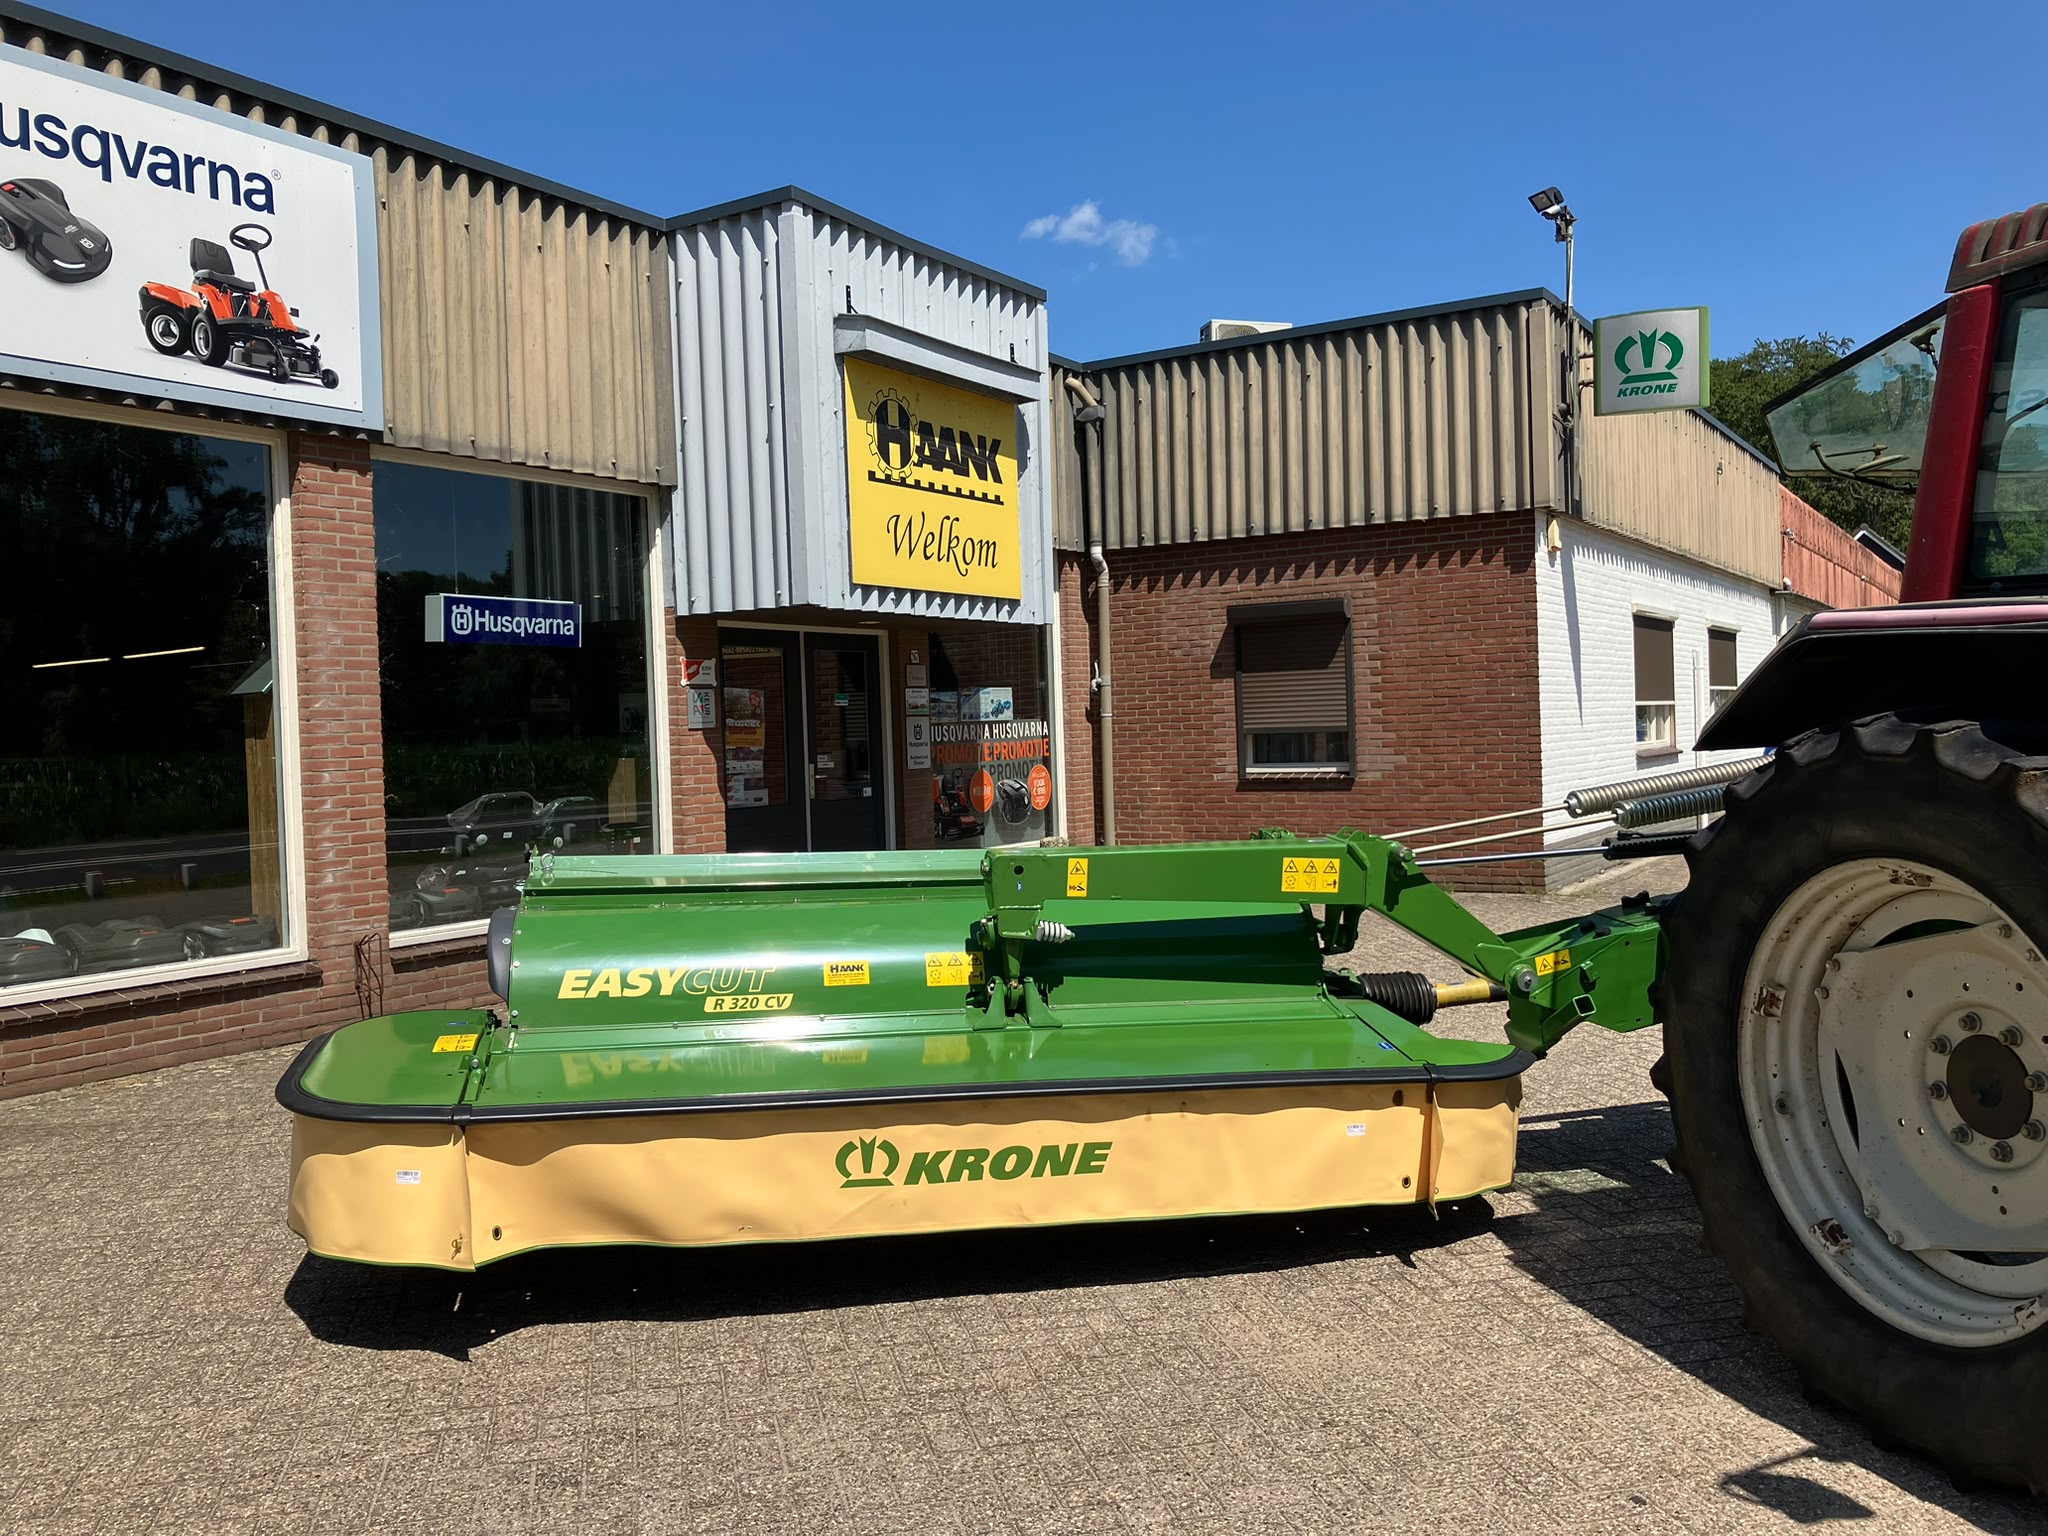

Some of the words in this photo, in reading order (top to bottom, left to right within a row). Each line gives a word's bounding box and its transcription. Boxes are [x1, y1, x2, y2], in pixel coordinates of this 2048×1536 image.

[1617, 383, 1678, 398] KRONE
[876, 399, 1003, 484] HAANK
[887, 511, 998, 577] Welkom
[474, 609, 575, 637] Husqvarna
[993, 721, 1049, 739] HUSQVARNA
[993, 738, 1050, 761] PROMOTIE
[830, 964, 864, 973] HAANK
[557, 966, 776, 999] EASYCUT
[713, 997, 724, 1010] R
[729, 997, 758, 1009] 320
[765, 995, 788, 1008] CV
[903, 1141, 1113, 1186] KRONE
